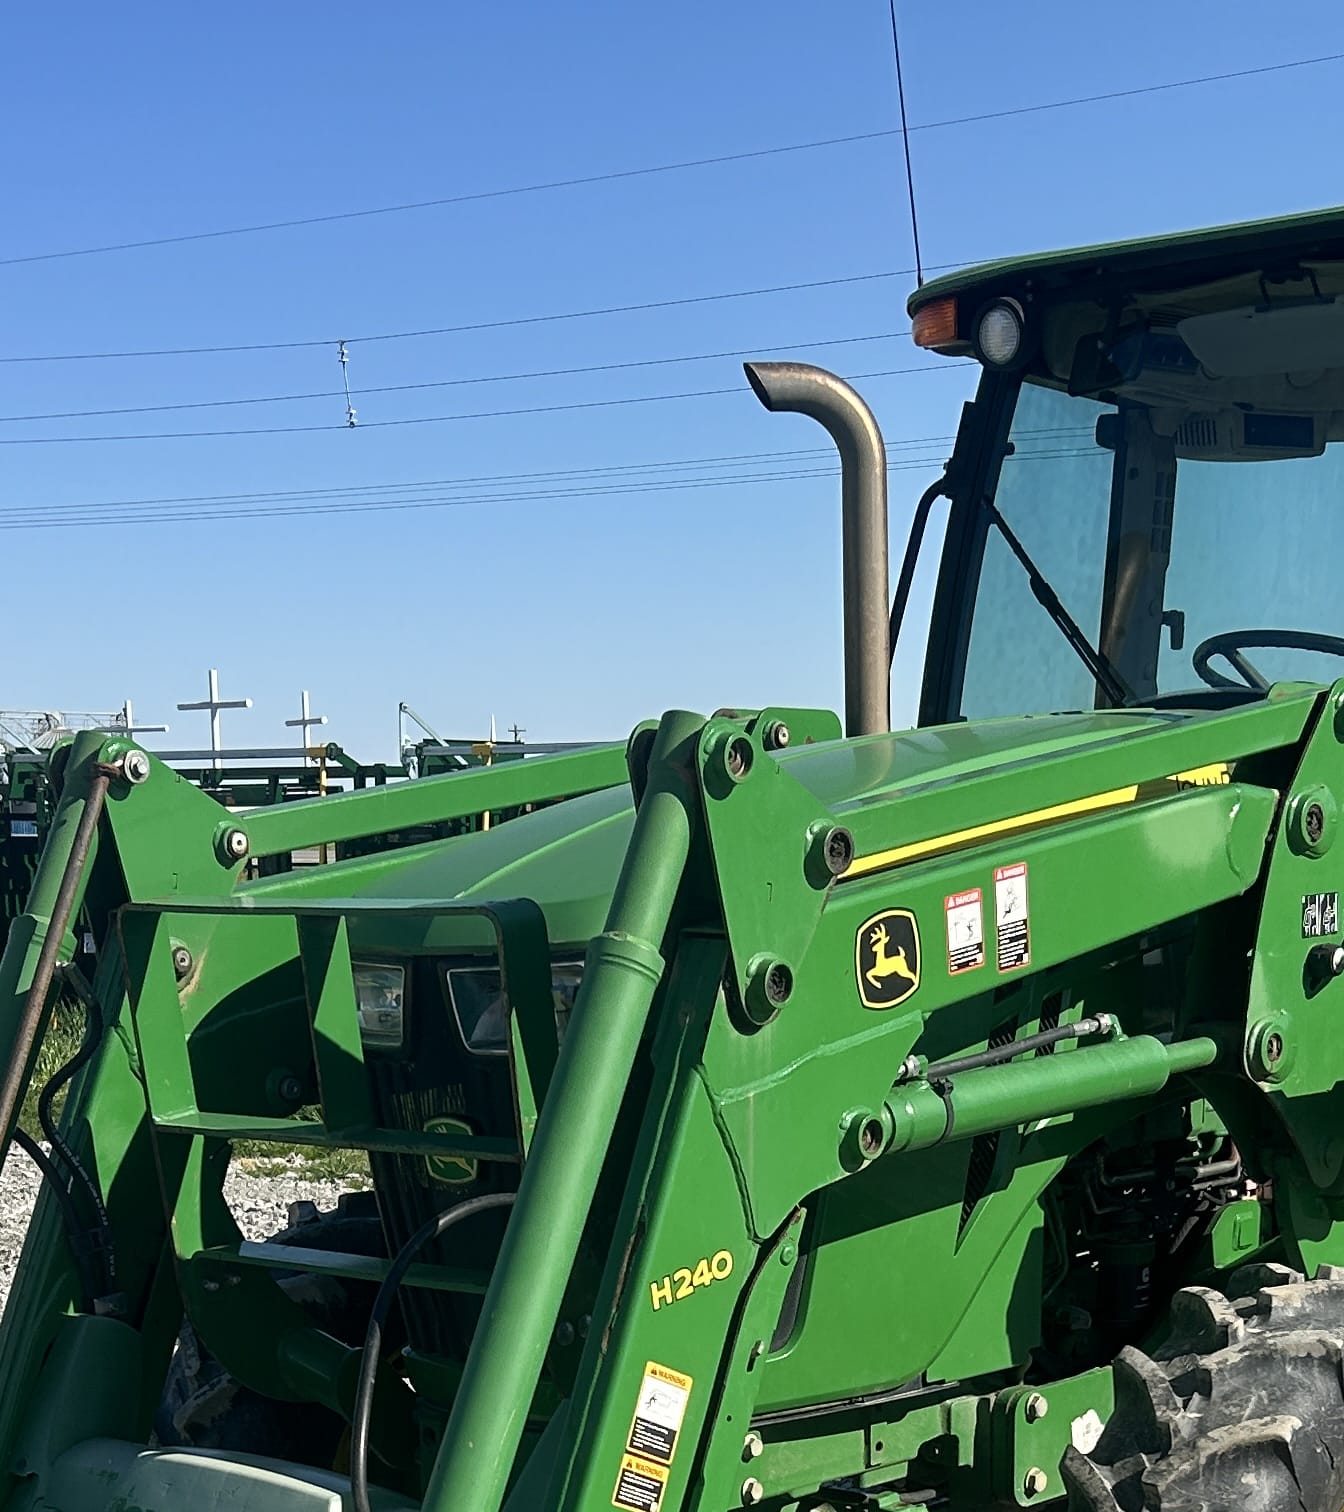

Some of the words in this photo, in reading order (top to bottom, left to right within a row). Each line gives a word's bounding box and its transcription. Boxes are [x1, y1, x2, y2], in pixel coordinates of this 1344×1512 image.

[649, 1248, 735, 1312] H240
[658, 1369, 686, 1387] WARNING
[635, 1461, 663, 1478] WARNING
